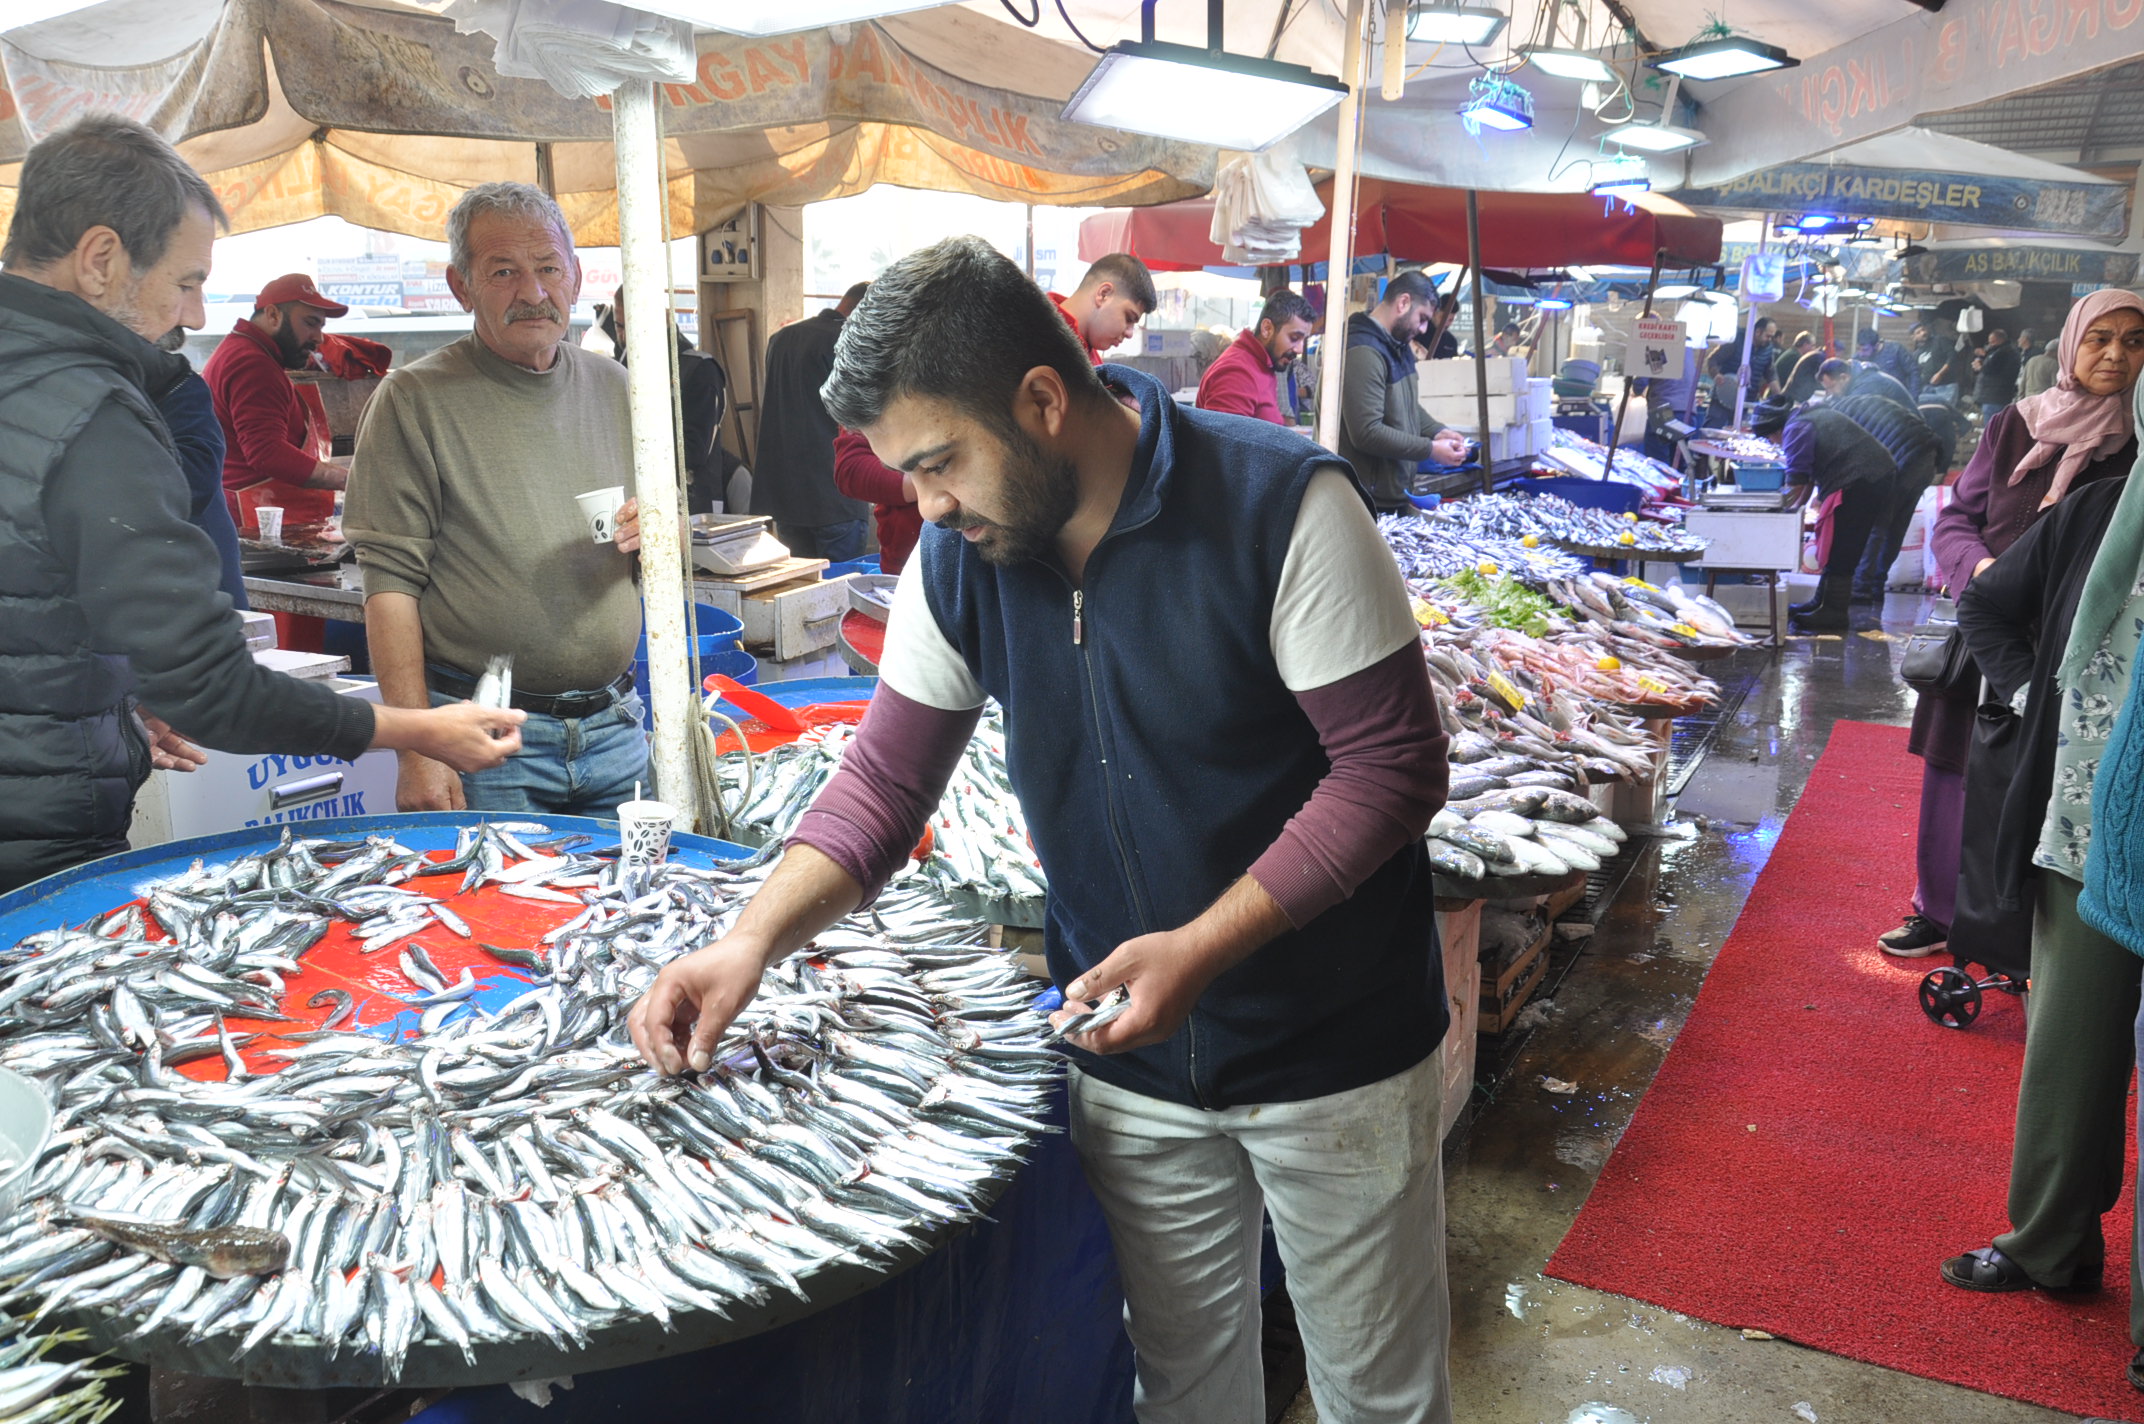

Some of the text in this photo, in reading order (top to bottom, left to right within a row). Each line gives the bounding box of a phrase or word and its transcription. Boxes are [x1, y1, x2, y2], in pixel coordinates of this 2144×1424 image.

[1833, 175, 1982, 209] KARDEŞLER
[1965, 251, 2081, 275] AS BALIKÇILIK
[327, 284, 400, 296] KONTUR
